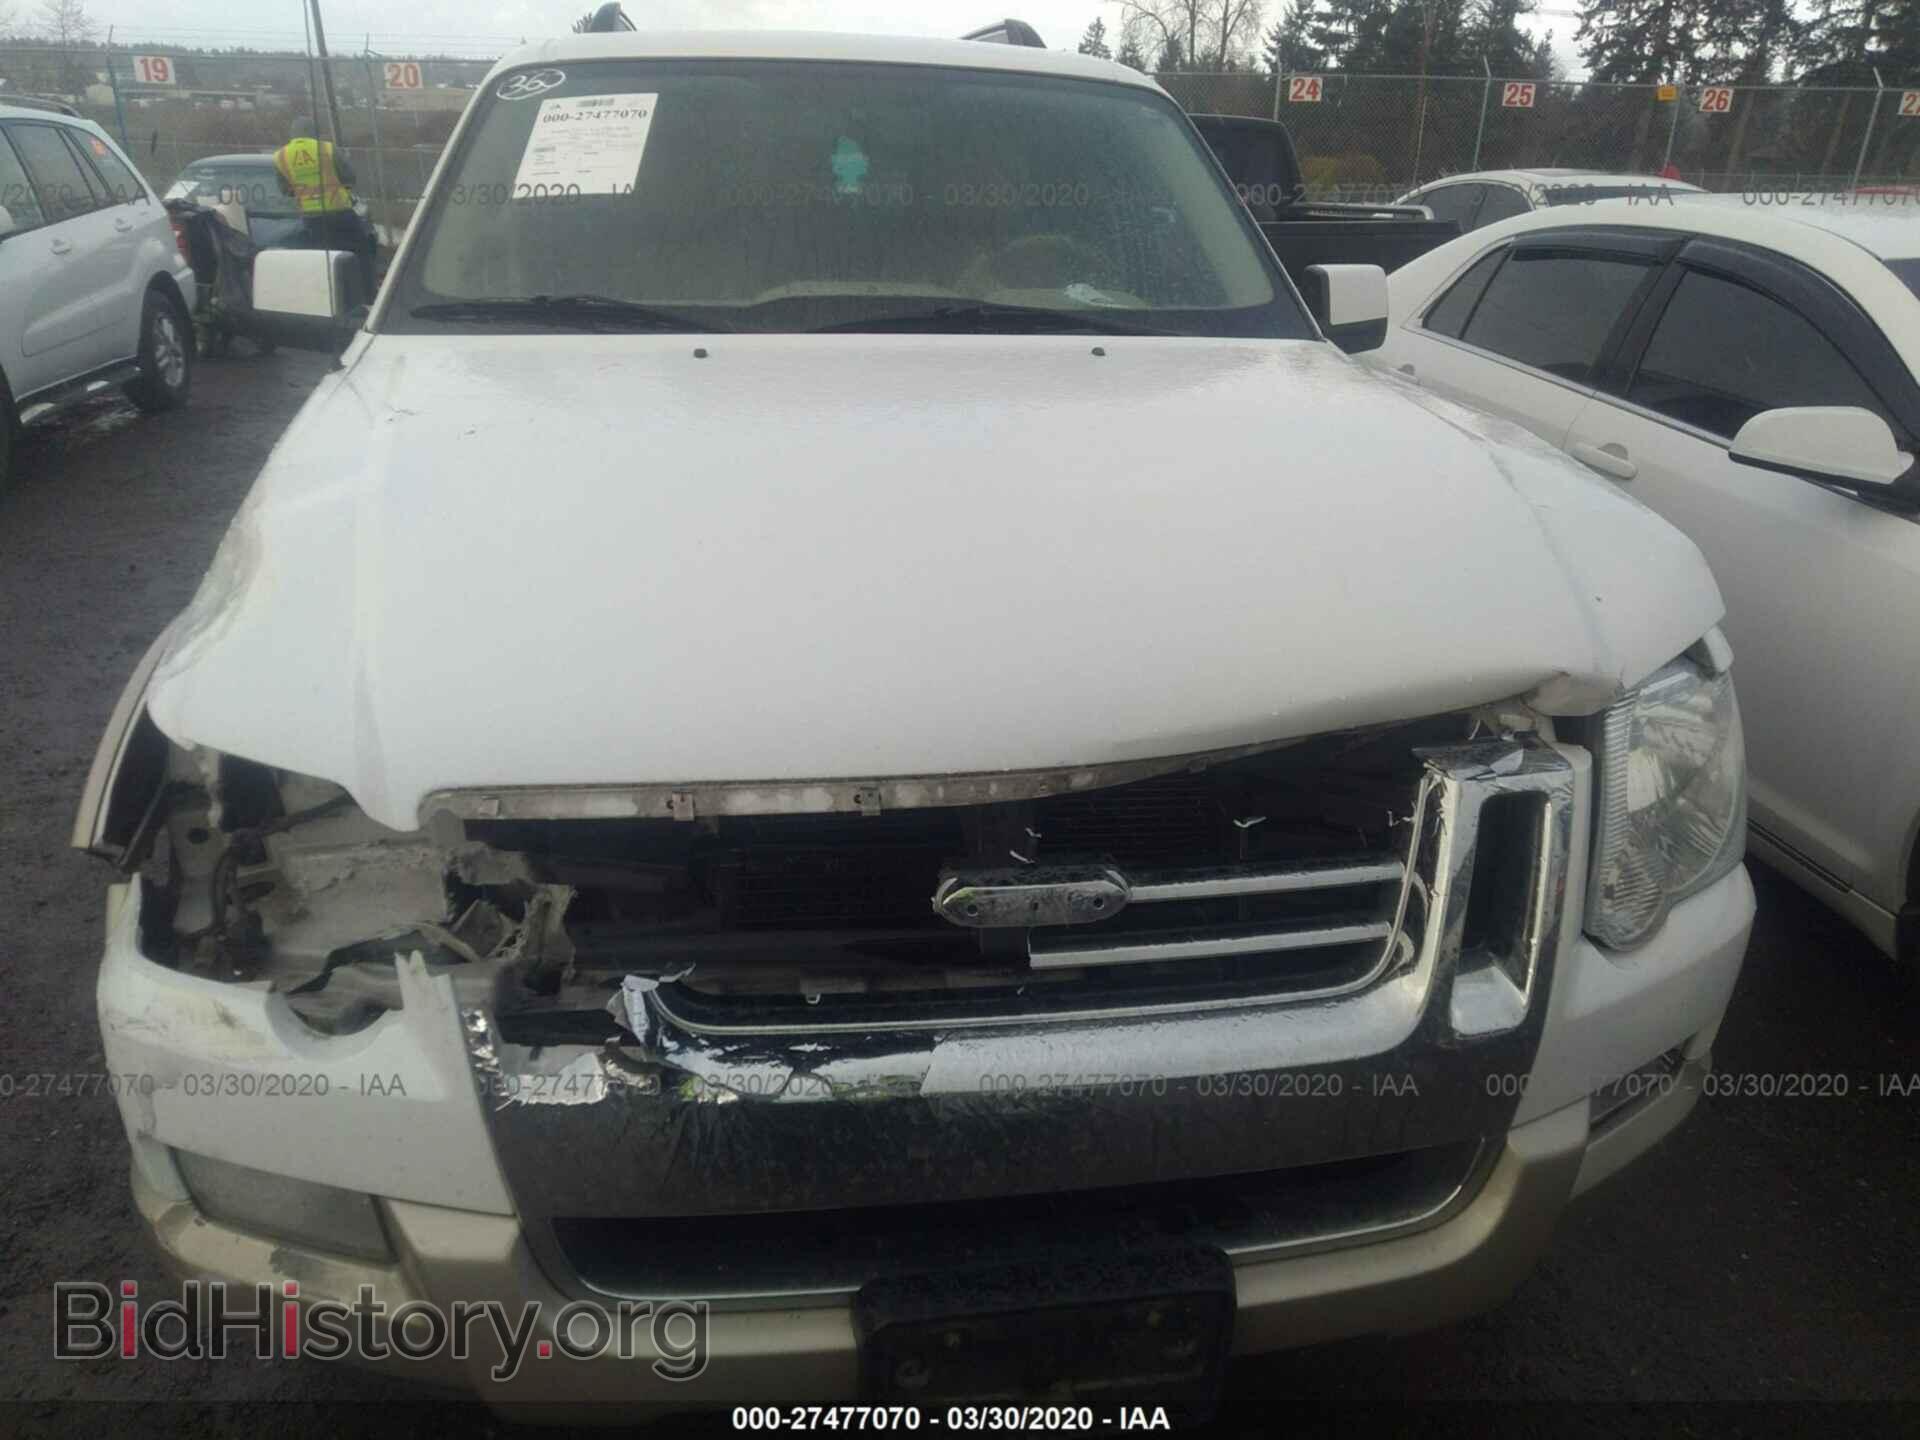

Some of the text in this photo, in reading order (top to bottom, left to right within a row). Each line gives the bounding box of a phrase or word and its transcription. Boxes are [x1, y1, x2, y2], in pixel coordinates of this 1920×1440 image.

[140, 58, 168, 82] 19
[387, 64, 418, 88] 20
[1292, 79, 1319, 101] 24
[1505, 85, 1532, 106] 25
[1702, 90, 1729, 112] 26
[542, 108, 648, 124] 000-27477070
